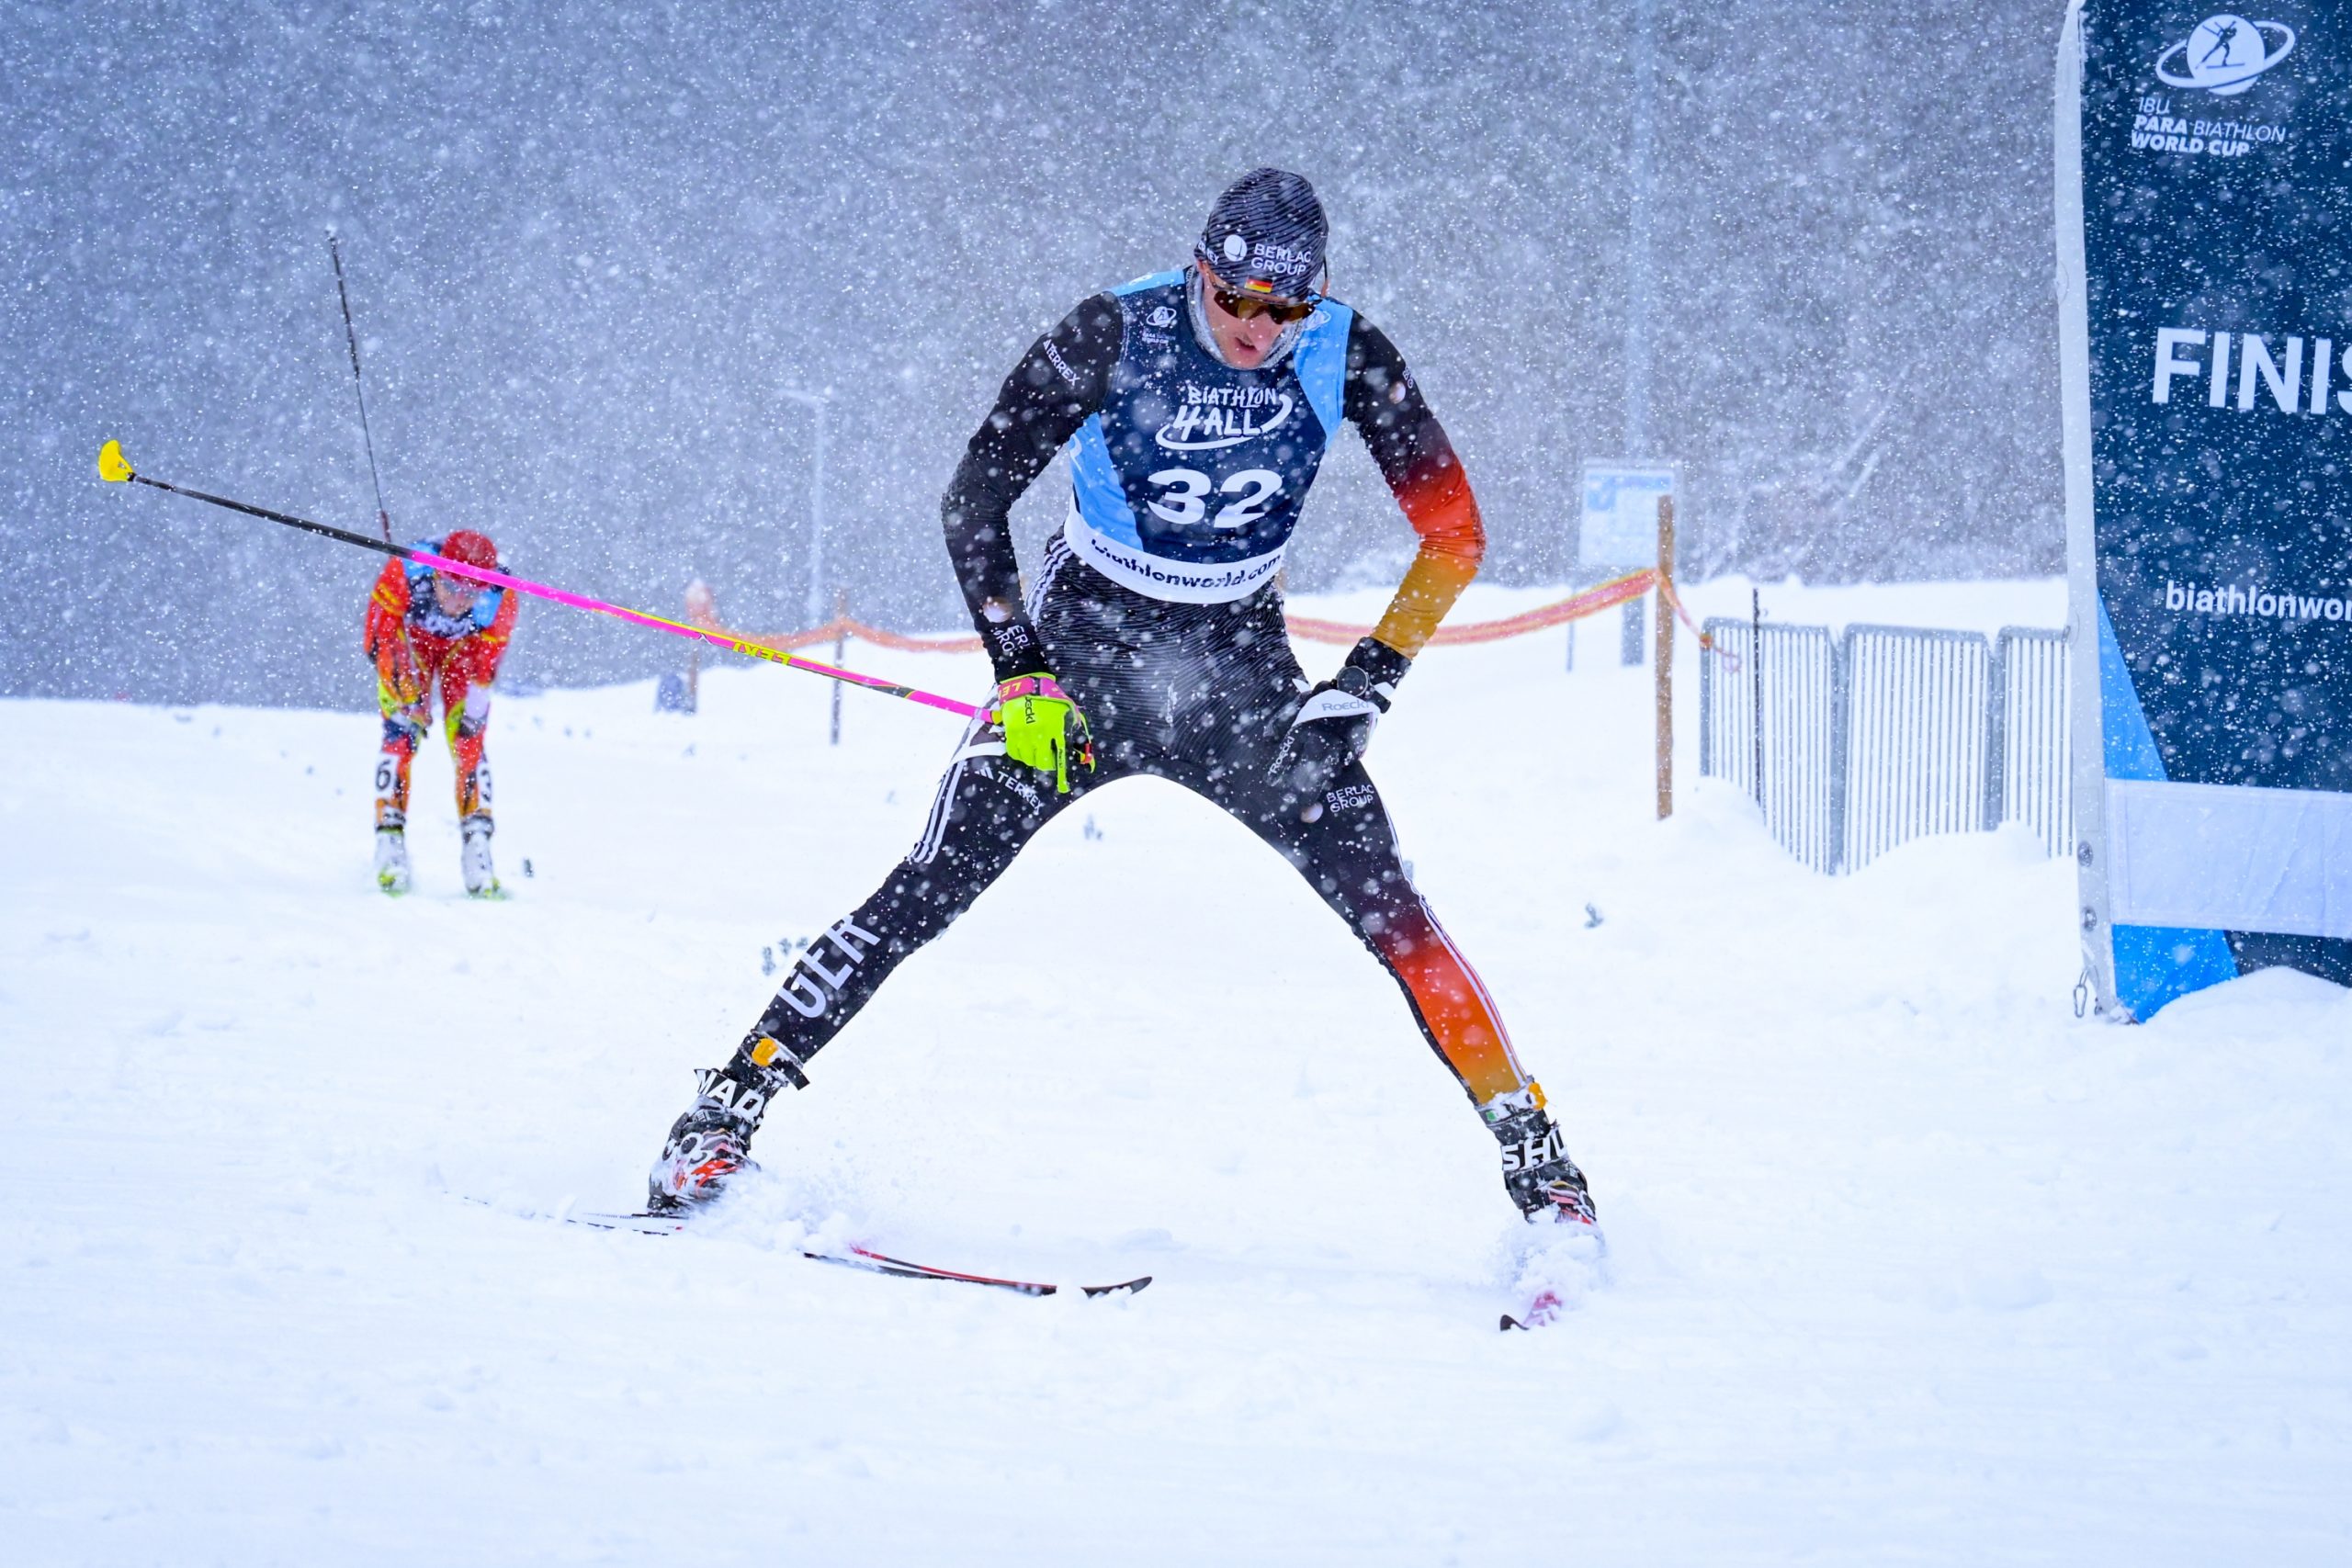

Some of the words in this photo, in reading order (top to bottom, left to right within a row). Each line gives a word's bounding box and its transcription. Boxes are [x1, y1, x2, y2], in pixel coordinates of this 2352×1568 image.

[2139, 96, 2170, 115] IBU
[2132, 115, 2188, 135] PARA
[2193, 119, 2287, 142] BIATHLON
[2131, 130, 2205, 154] WORLD
[2208, 139, 2250, 157] CUP
[1251, 257, 1306, 276] GROUP
[1254, 243, 1312, 264] BERLAC
[1046, 343, 1081, 387] TERREX
[1172, 405, 1261, 441] 4ALL
[1147, 468, 1283, 529] 32
[733, 642, 792, 665] LEKI
[376, 759, 391, 791] 6
[997, 770, 1045, 816] TERREX
[1326, 784, 1374, 803] BERLAC
[1329, 795, 1374, 813] GROUP
